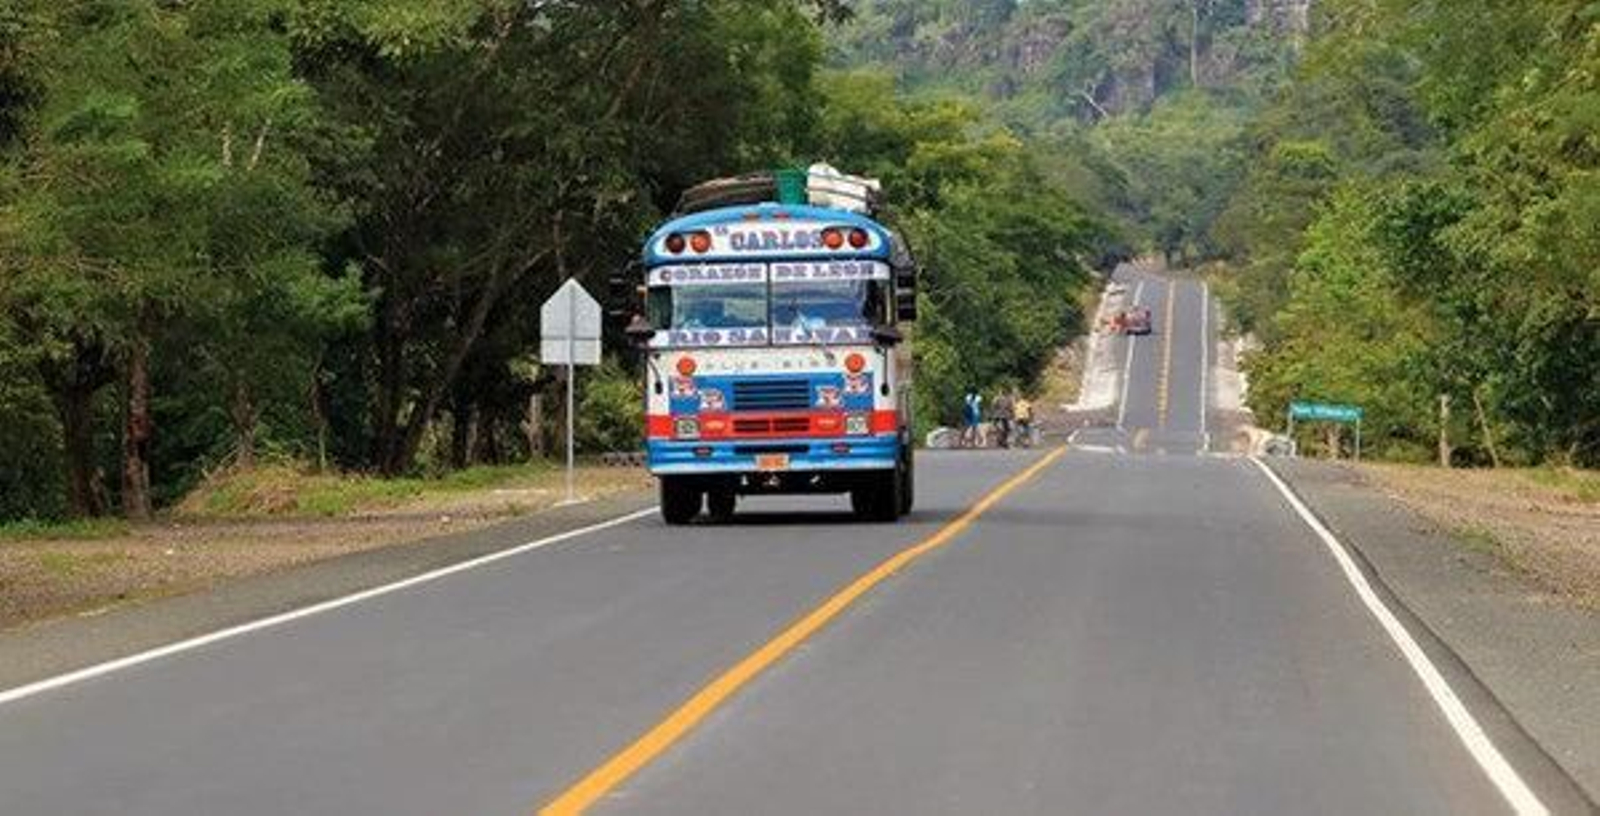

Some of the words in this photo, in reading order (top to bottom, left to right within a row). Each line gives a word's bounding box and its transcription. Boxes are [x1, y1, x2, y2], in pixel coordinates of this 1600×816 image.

[730, 230, 823, 251] CARLOS
[775, 264, 808, 277] DE
[668, 331, 721, 346] RIO
[728, 329, 792, 345] SAN
